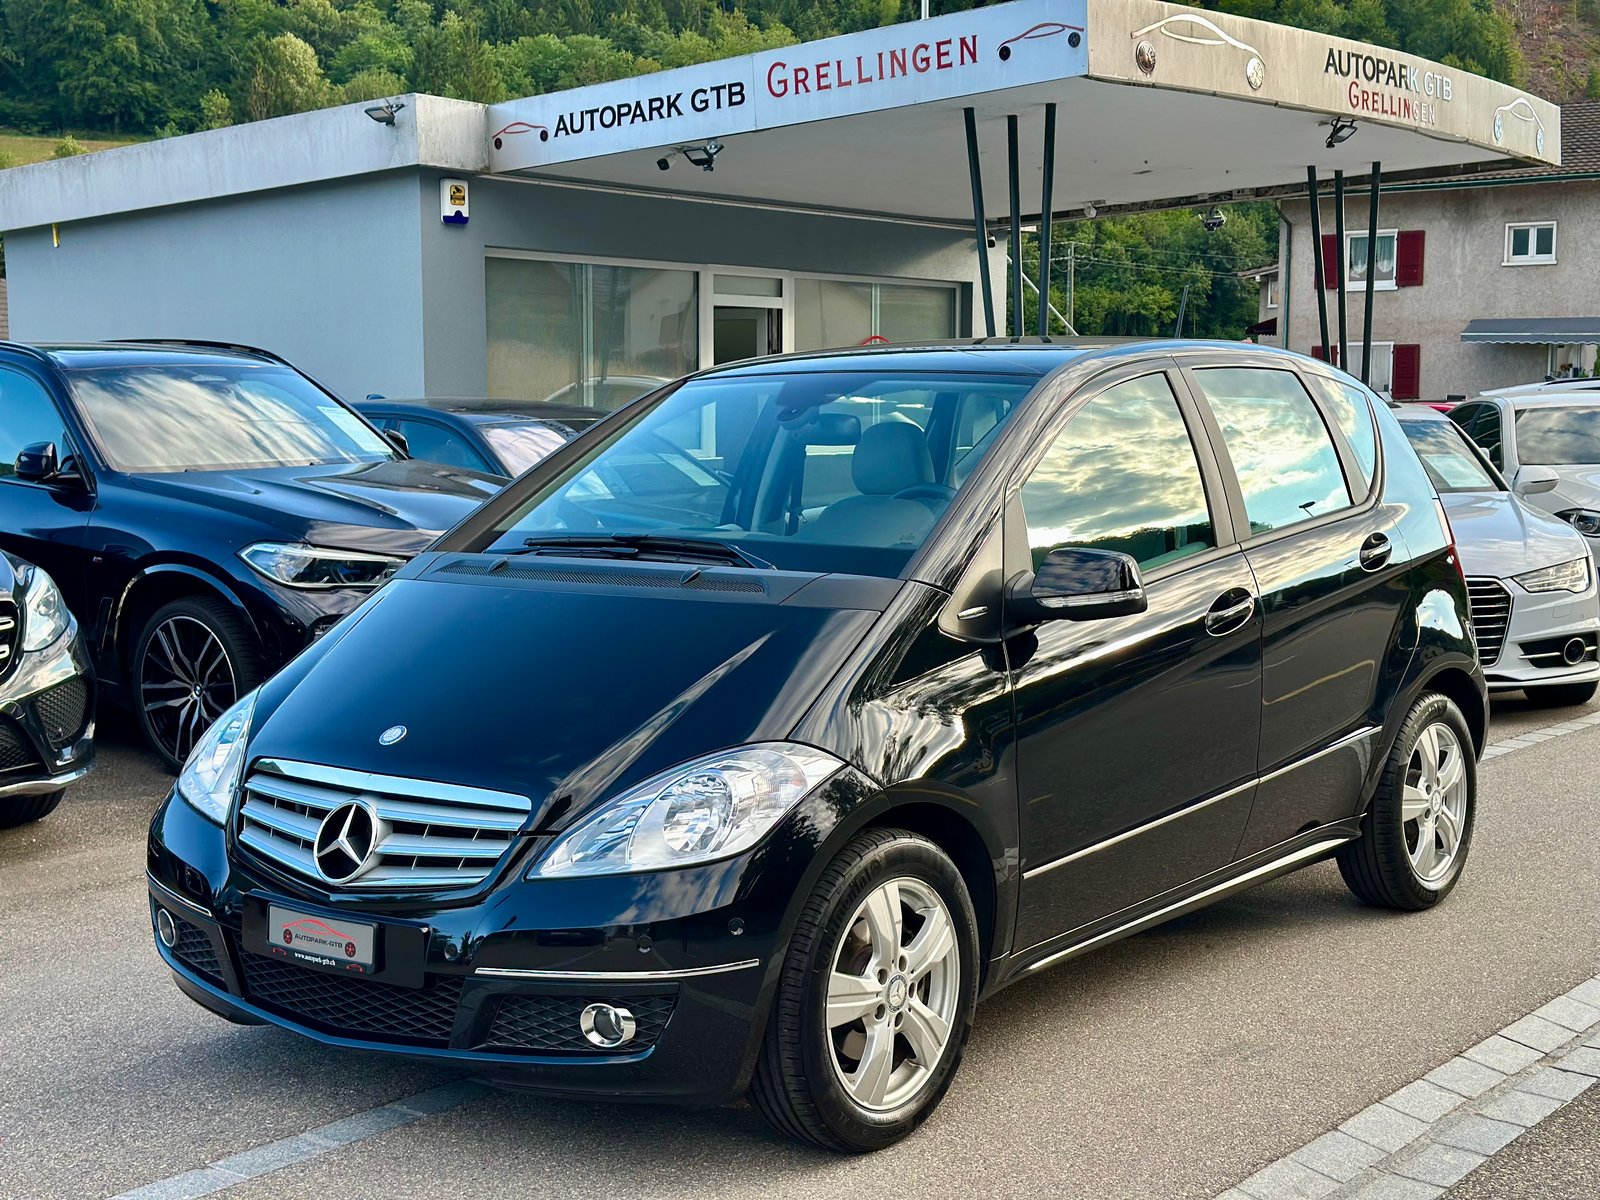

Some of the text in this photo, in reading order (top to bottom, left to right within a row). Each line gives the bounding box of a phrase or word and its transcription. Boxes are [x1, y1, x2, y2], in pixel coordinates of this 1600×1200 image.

[767, 34, 979, 98] GRELLINGEN
[1324, 47, 1452, 101] AUTOPARK GTB
[554, 81, 746, 138] AUTOPARK GTB
[1348, 81, 1435, 125] GRELLINGEN
[294, 933, 343, 948] AUTOPARK-GTB
